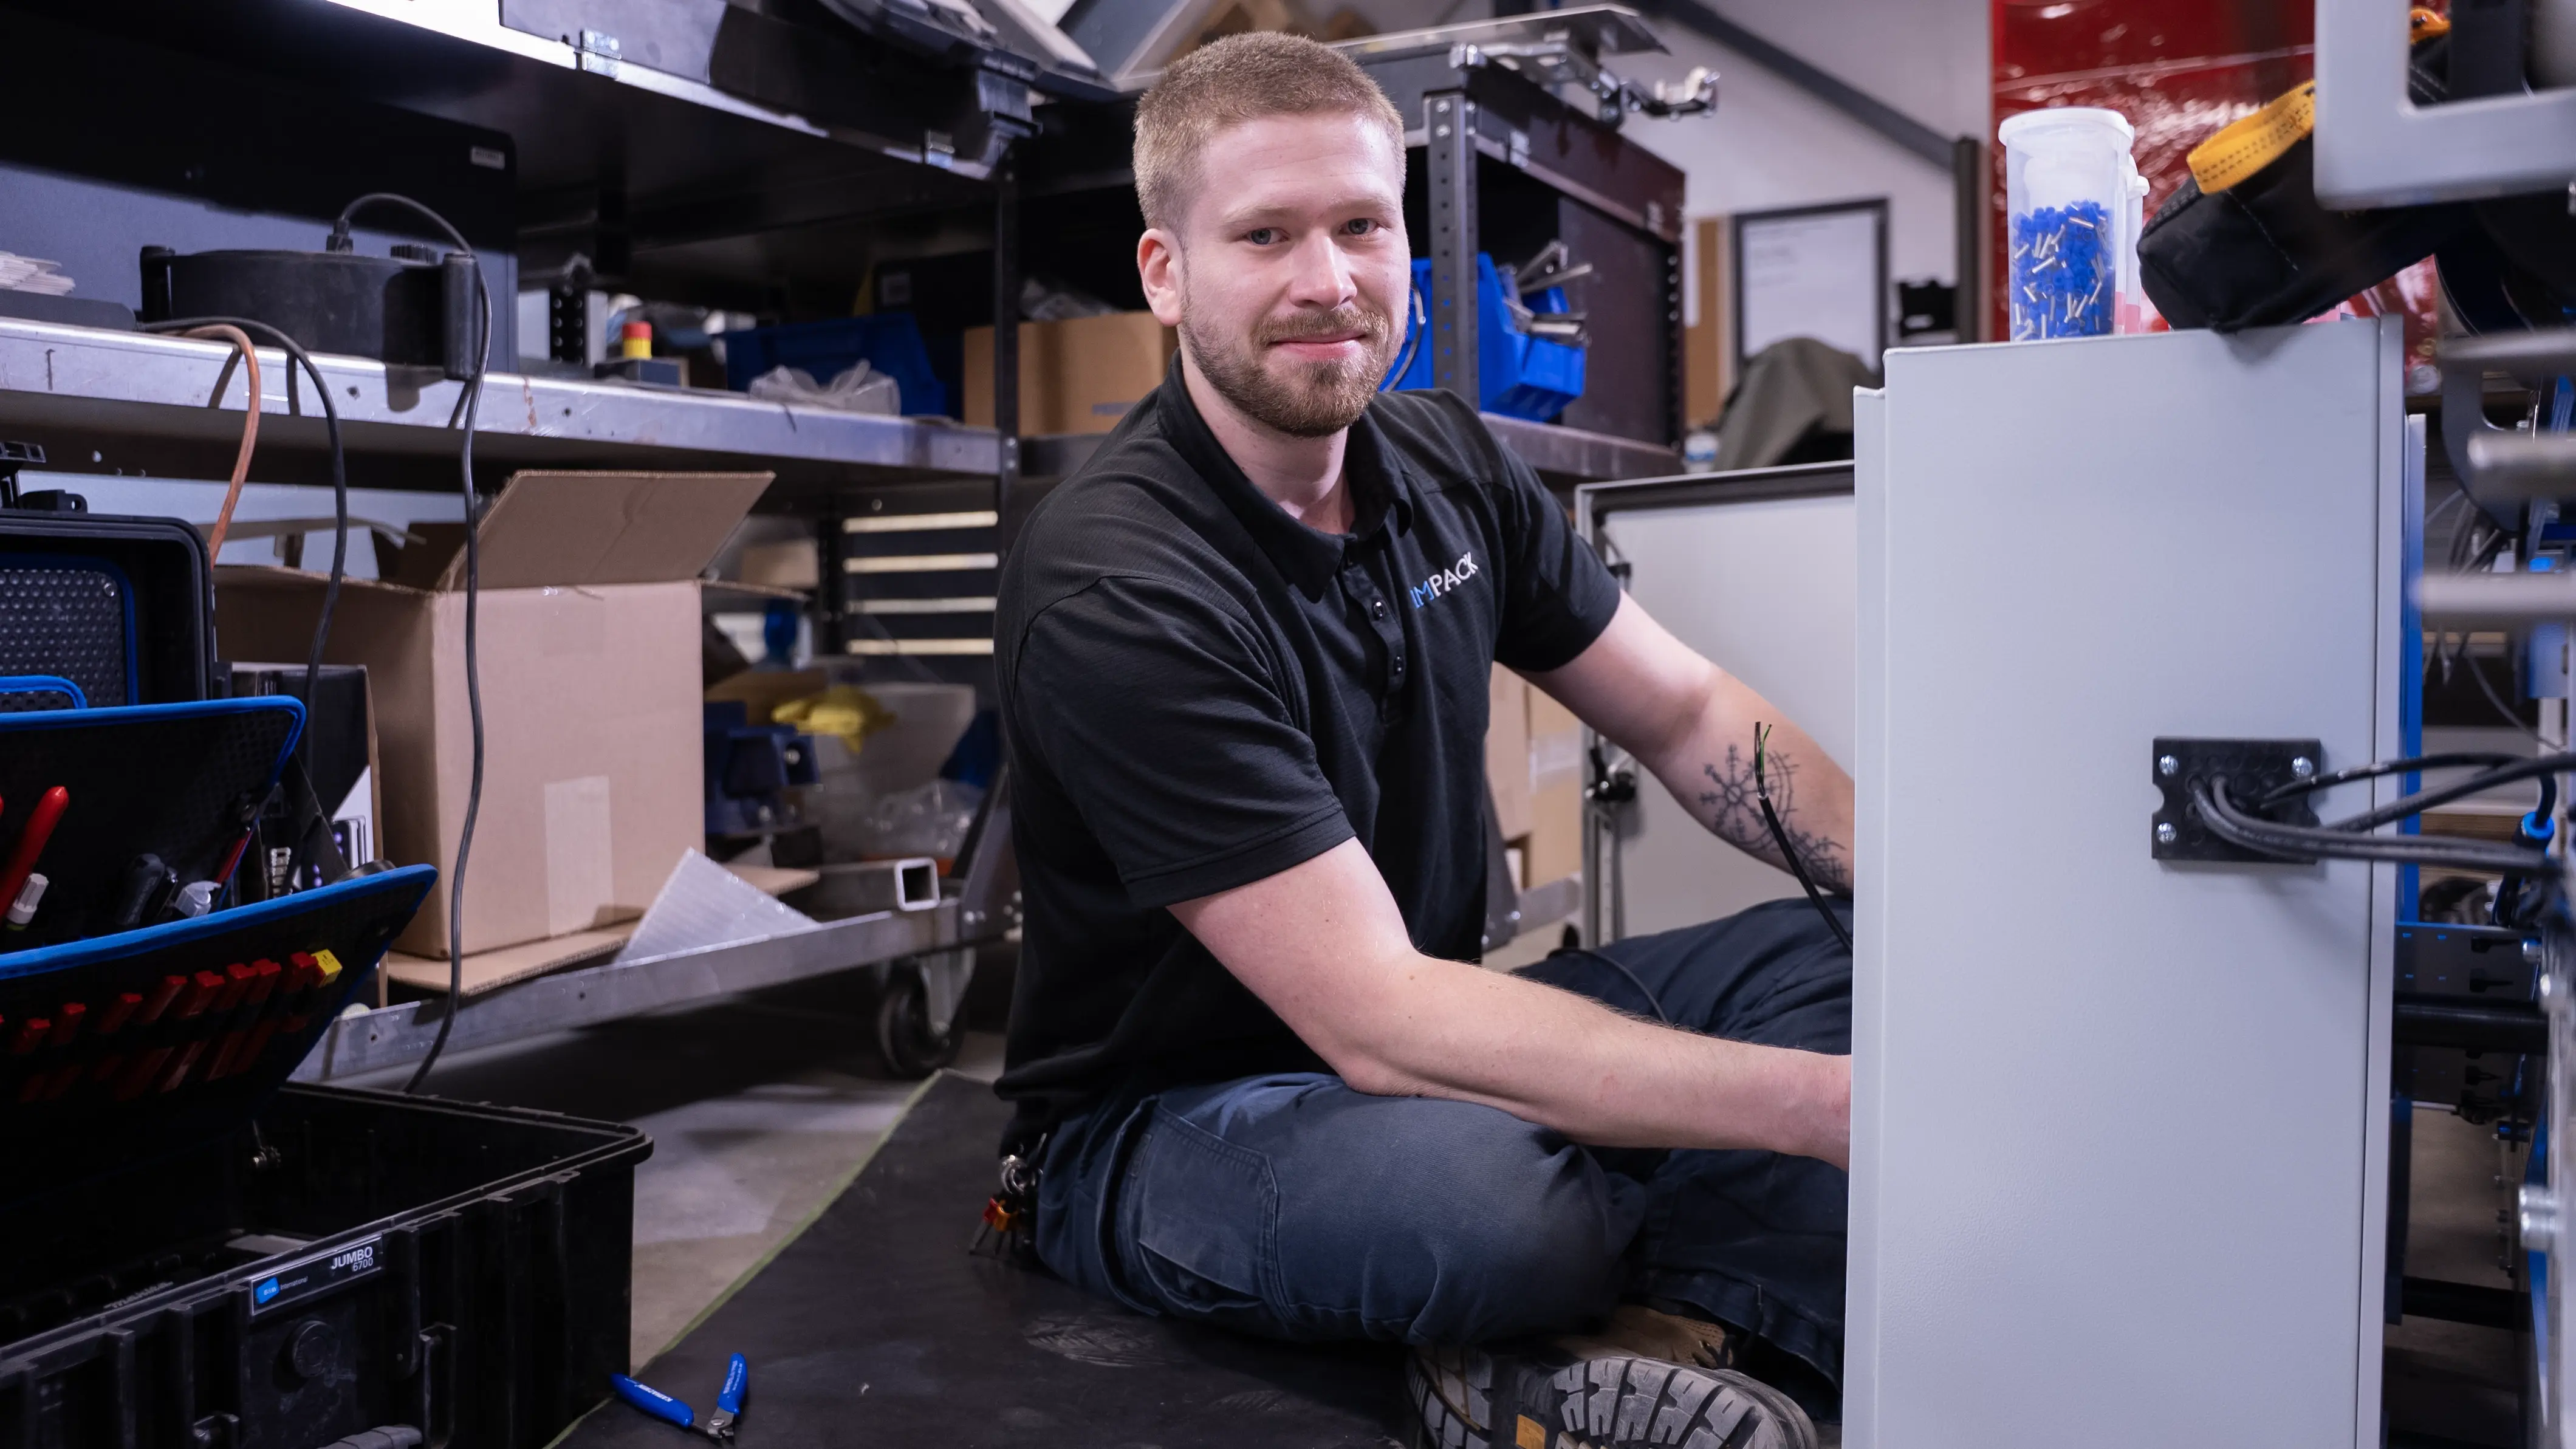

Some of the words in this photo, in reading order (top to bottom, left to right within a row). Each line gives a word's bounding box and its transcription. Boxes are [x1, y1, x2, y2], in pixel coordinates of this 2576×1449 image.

[1410, 551, 1478, 608] IMPACK
[331, 1246, 373, 1269] JUMBO
[352, 1257, 373, 1272] 6700
